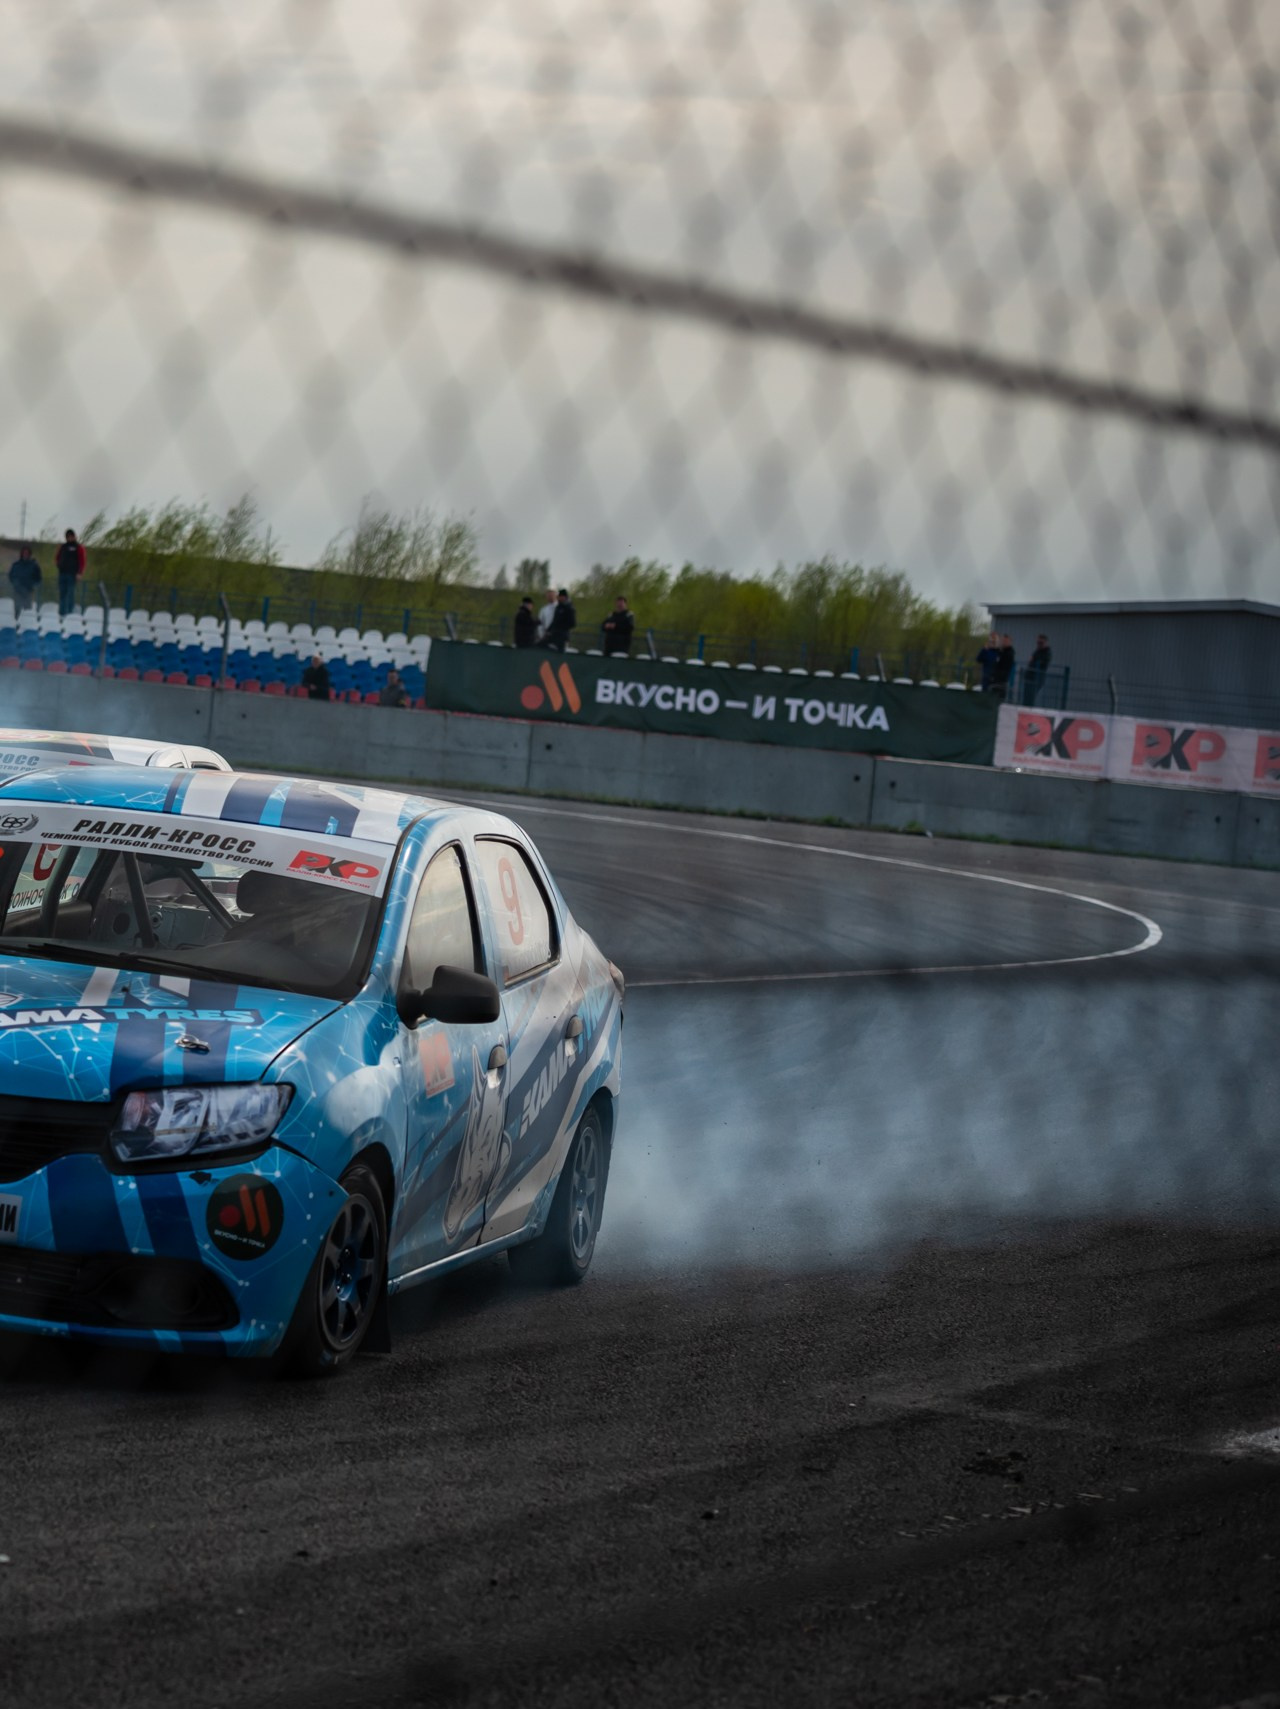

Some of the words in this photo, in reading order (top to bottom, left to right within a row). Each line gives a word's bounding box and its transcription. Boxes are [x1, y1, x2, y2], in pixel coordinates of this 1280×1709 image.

[595, 678, 720, 715] ВКУСНО
[751, 695, 776, 721] И
[784, 697, 890, 732] ТОЧКА
[40, 832, 109, 844] ЧЕМПИОНАТ
[110, 838, 149, 848] КУБОК
[151, 842, 224, 859] ПЕРВЕНСТВО
[226, 853, 274, 868] РОССИИ
[73, 818, 257, 854] РАЛЛИ-КРОСС
[288, 850, 380, 880] РКР
[498, 857, 524, 945] 9
[104, 1009, 255, 1023] TYRES
